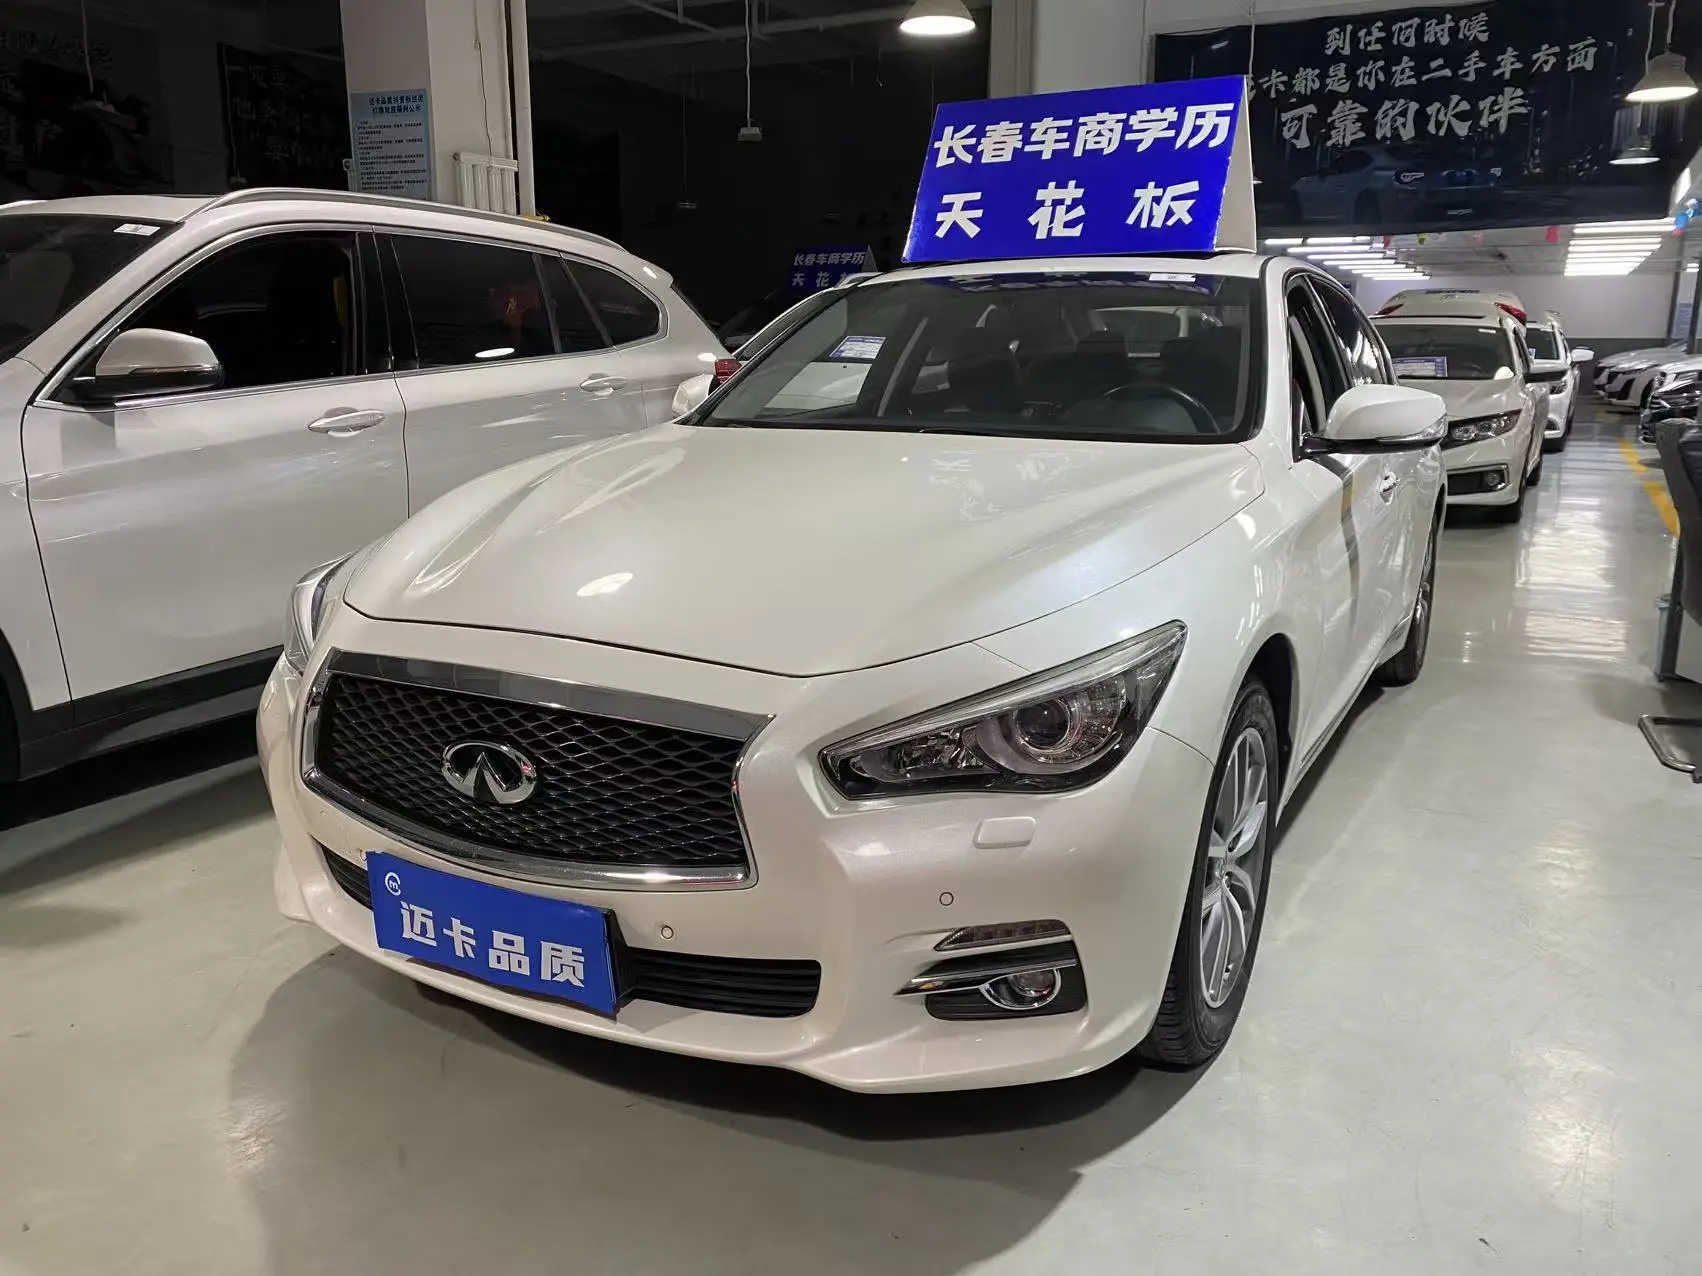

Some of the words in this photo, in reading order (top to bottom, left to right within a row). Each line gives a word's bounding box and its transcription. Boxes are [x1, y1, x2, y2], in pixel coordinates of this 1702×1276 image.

[1325, 12, 1490, 55] 到任何时候
[934, 102, 1235, 168] 长春车商学历
[1281, 86, 1529, 149] 可靠的伙伴
[935, 179, 1200, 240] 天花板
[793, 251, 866, 266] 长春车商学历
[400, 900, 585, 988] 迈卡品质
